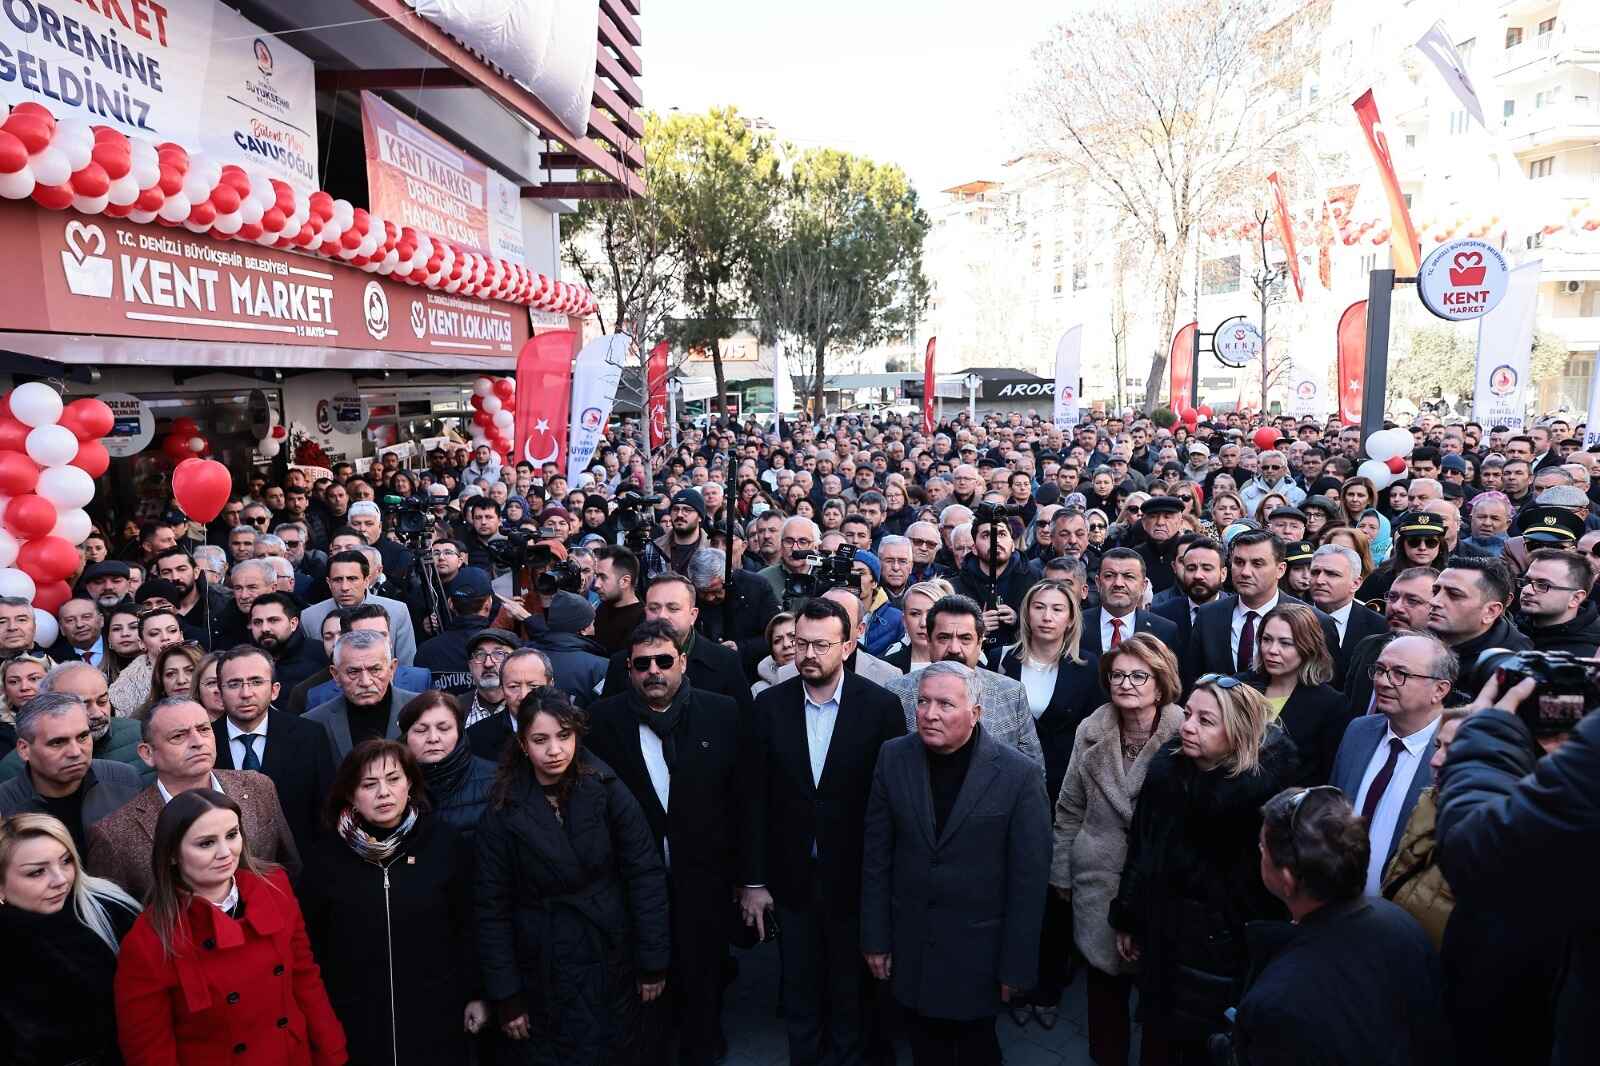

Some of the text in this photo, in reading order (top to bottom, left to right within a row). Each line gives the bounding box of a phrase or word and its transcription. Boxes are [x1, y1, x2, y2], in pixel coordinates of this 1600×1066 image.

[386, 134, 421, 177] KENT
[427, 157, 473, 203] MARKET
[116, 230, 288, 278] T.C. DENİZLİ BÜYÜKŞEHİR BELEDİYESİ
[121, 254, 334, 324] KENT MARKET
[1443, 290, 1490, 305] KENT
[428, 308, 458, 337] KENT
[460, 313, 513, 343] LOKANTASI
[1449, 306, 1484, 314] MARKET
